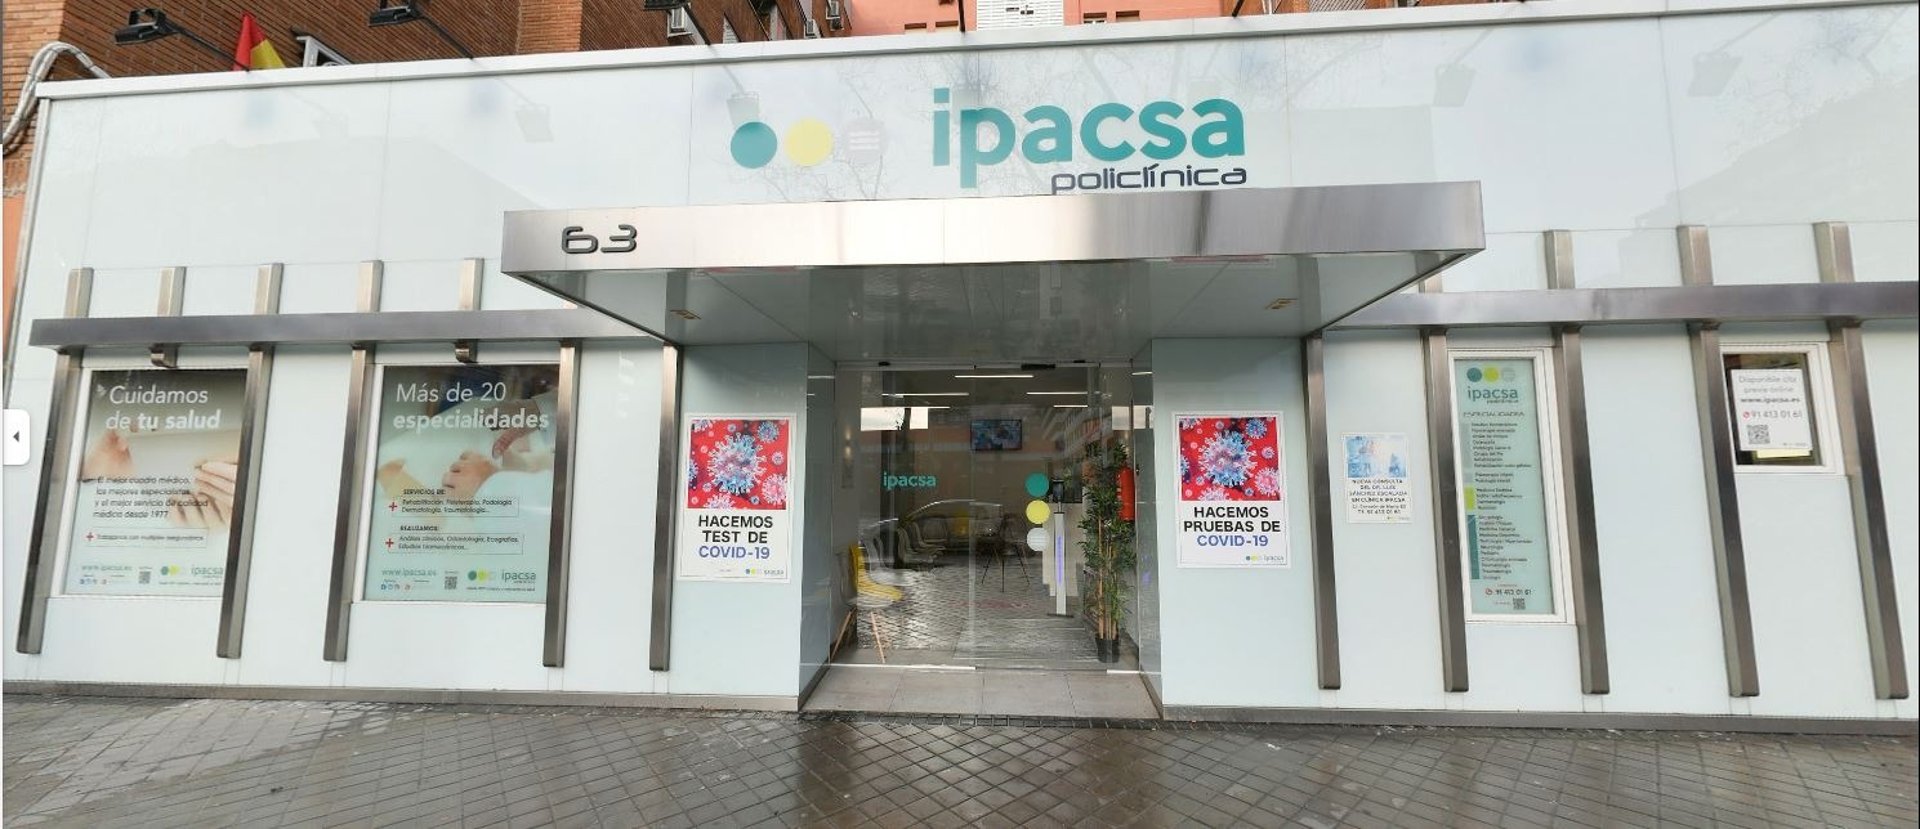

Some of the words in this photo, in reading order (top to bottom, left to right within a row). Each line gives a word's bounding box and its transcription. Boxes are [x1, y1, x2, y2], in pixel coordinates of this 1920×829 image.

[933, 88, 1245, 189] ipacsa
[1051, 163, 1247, 195] policlínica
[562, 224, 637, 254] 63
[109, 384, 208, 404] Cuidamos
[396, 383, 439, 403] Más
[446, 382, 473, 402] de
[480, 382, 506, 402] 20
[1467, 386, 1518, 402] ipacsa
[105, 410, 131, 429] de
[137, 412, 159, 429] tu
[165, 408, 221, 429] salud
[393, 407, 549, 433] especialidades
[883, 471, 937, 490] ipacsa
[151, 510, 168, 518] 1977
[1193, 506, 1269, 518] HACEMOS
[698, 515, 773, 528] HACEMOS
[1183, 521, 1254, 532] PRUEBAS
[1261, 521, 1281, 532] DE
[702, 530, 741, 543] TEST
[748, 531, 768, 544] DE
[1197, 535, 1269, 547] COVID-19
[698, 545, 770, 560] COVID-19
[381, 568, 437, 577] www.ipacsa.es
[501, 569, 537, 582] ipacsa
